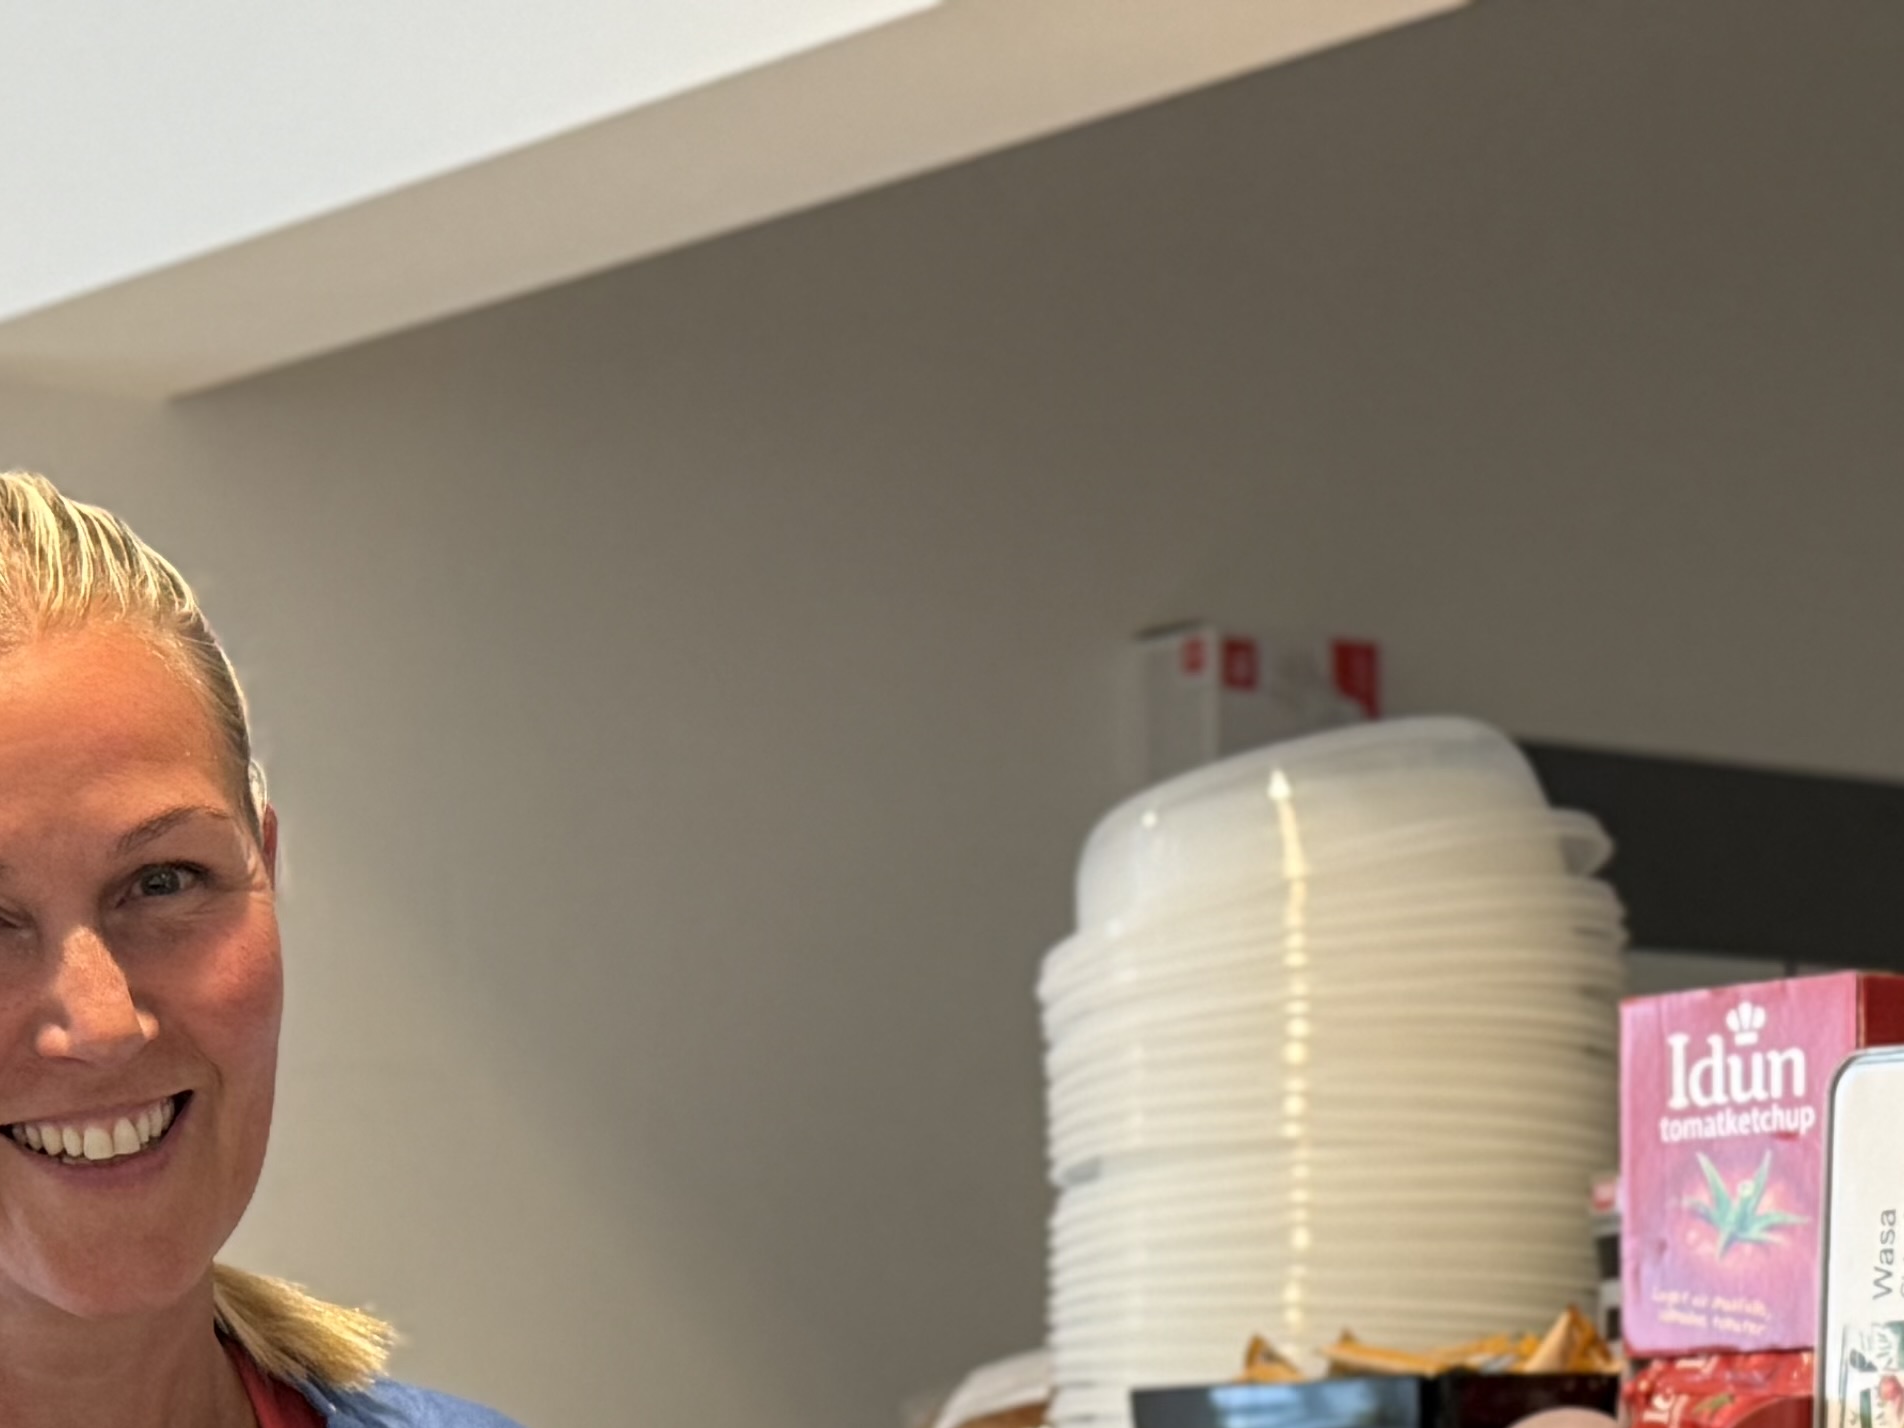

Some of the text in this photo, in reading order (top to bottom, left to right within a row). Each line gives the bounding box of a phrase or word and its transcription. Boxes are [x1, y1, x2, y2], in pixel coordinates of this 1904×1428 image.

[1667, 1032, 1806, 1110] Idun
[1659, 1103, 1816, 1143] tomatketchup
[1873, 1209, 1896, 1300] Wasa
